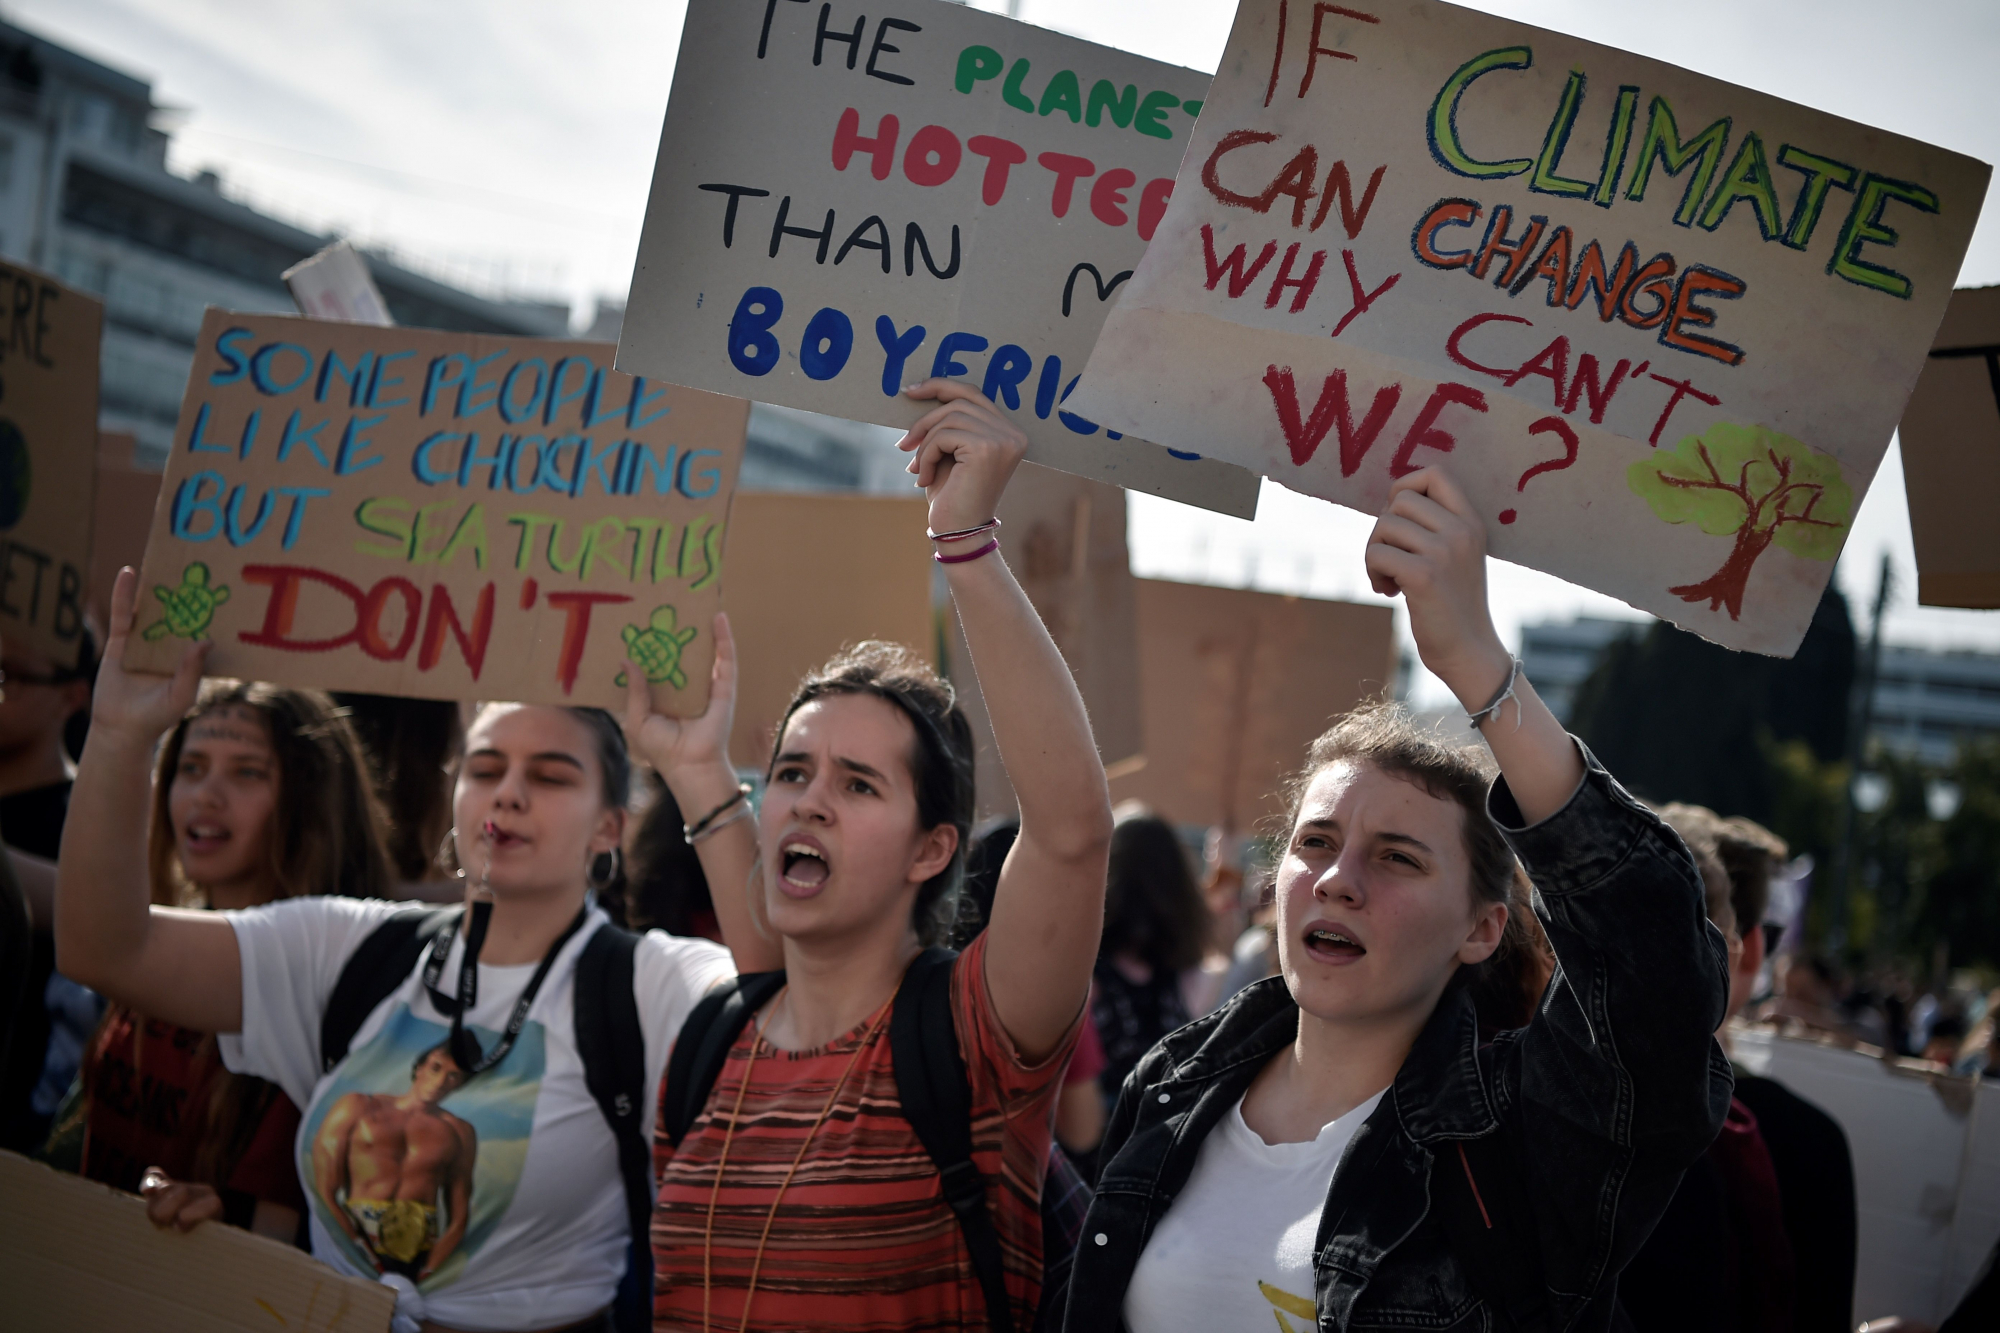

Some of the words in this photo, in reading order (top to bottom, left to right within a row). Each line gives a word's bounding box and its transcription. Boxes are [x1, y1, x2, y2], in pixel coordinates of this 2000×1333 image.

[757, 0, 923, 86] THE
[1264, 0, 1380, 107] IF
[1427, 45, 1942, 301] CLIMATE
[699, 184, 961, 280] THAN
[1201, 129, 1387, 240] CAN
[1411, 197, 1748, 367] CHANGE
[209, 327, 418, 409] SOME
[419, 347, 673, 430] PEOPLE
[1201, 224, 1402, 337] WHY
[1446, 313, 1722, 447] CAN'T
[188, 402, 388, 475] LIKE
[411, 430, 723, 501] CHOCKING
[170, 470, 331, 551] BUT
[354, 497, 489, 572] SEA
[507, 512, 726, 591] TURTLES
[237, 564, 634, 696] DON'T
